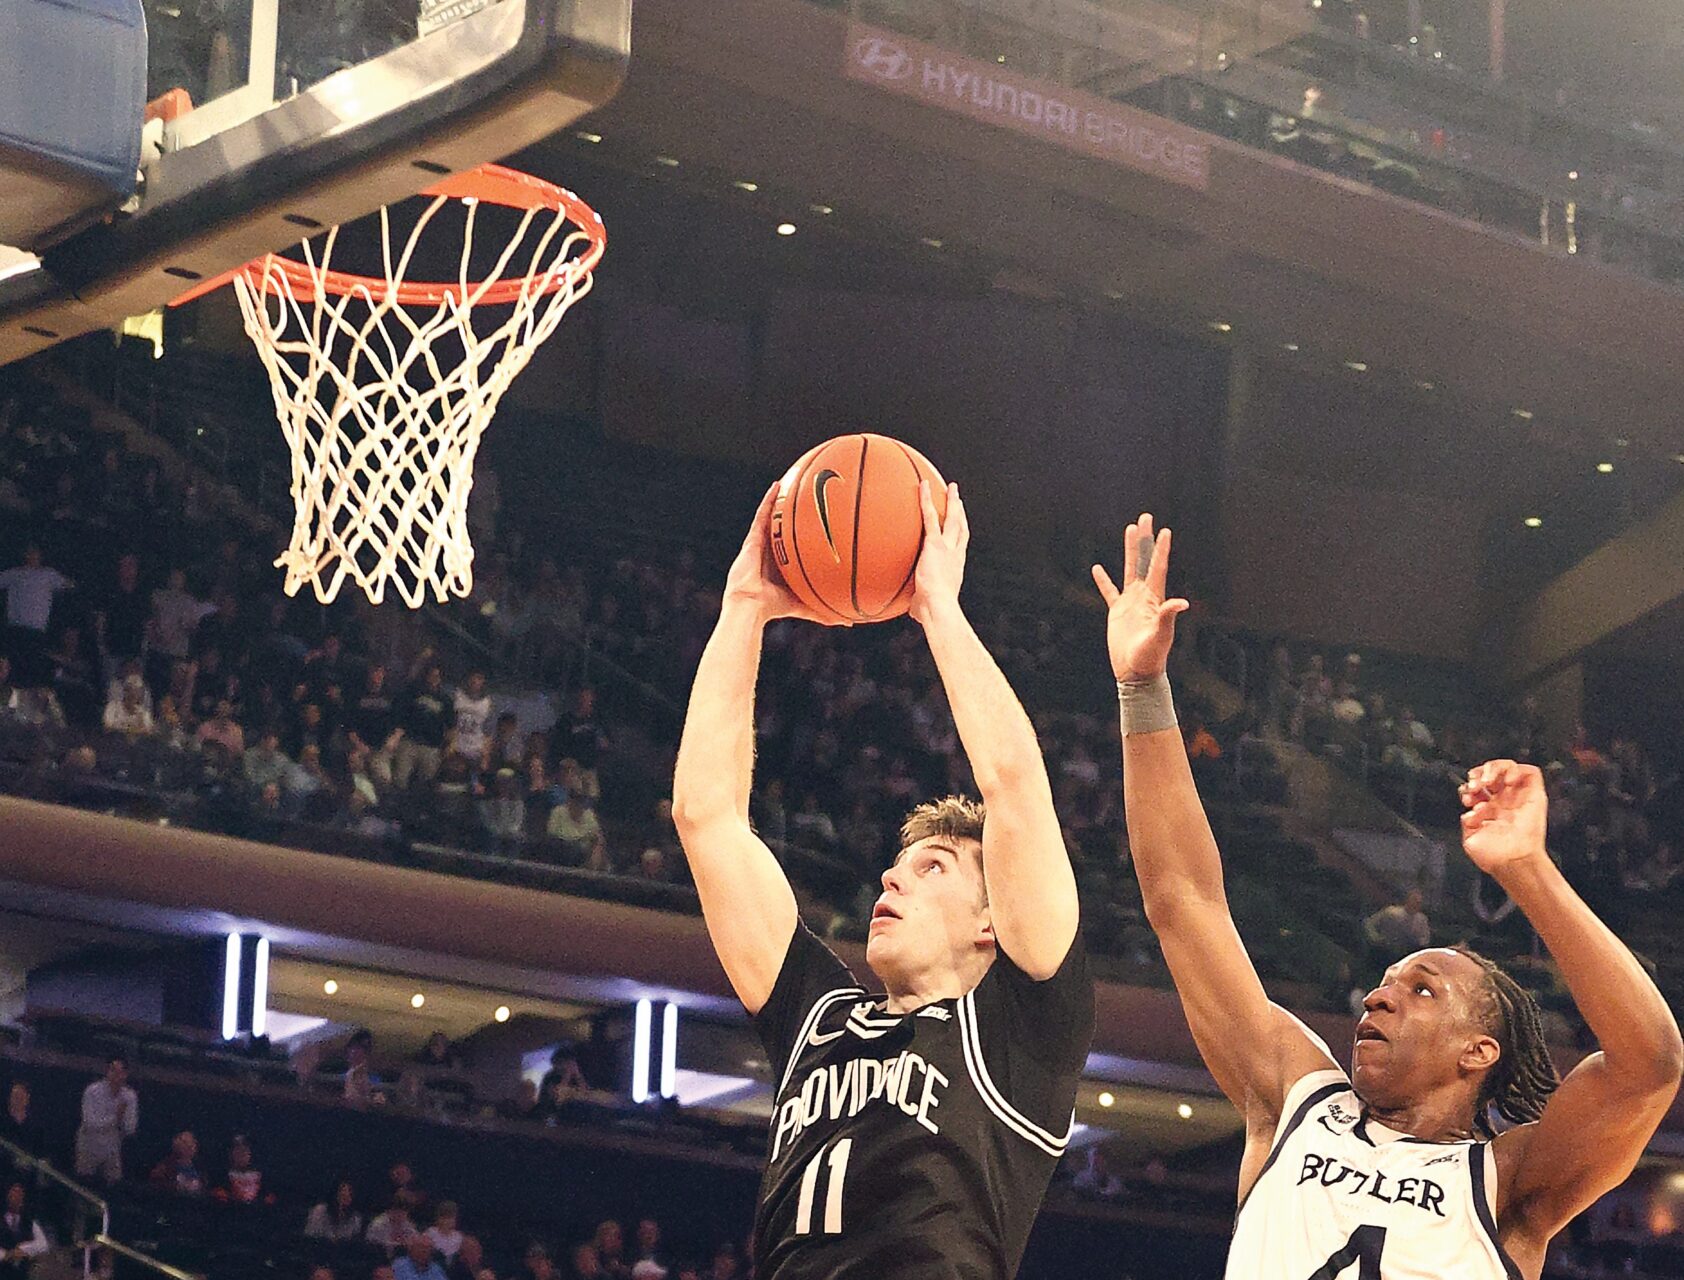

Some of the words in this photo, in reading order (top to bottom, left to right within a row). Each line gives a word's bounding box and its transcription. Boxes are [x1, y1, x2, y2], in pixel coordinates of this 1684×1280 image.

[922, 58, 1077, 134] HYUNDAI
[770, 1050, 949, 1164] POVIDNCE
[795, 1138, 852, 1234] 11
[1296, 1153, 1446, 1217] BUTLER
